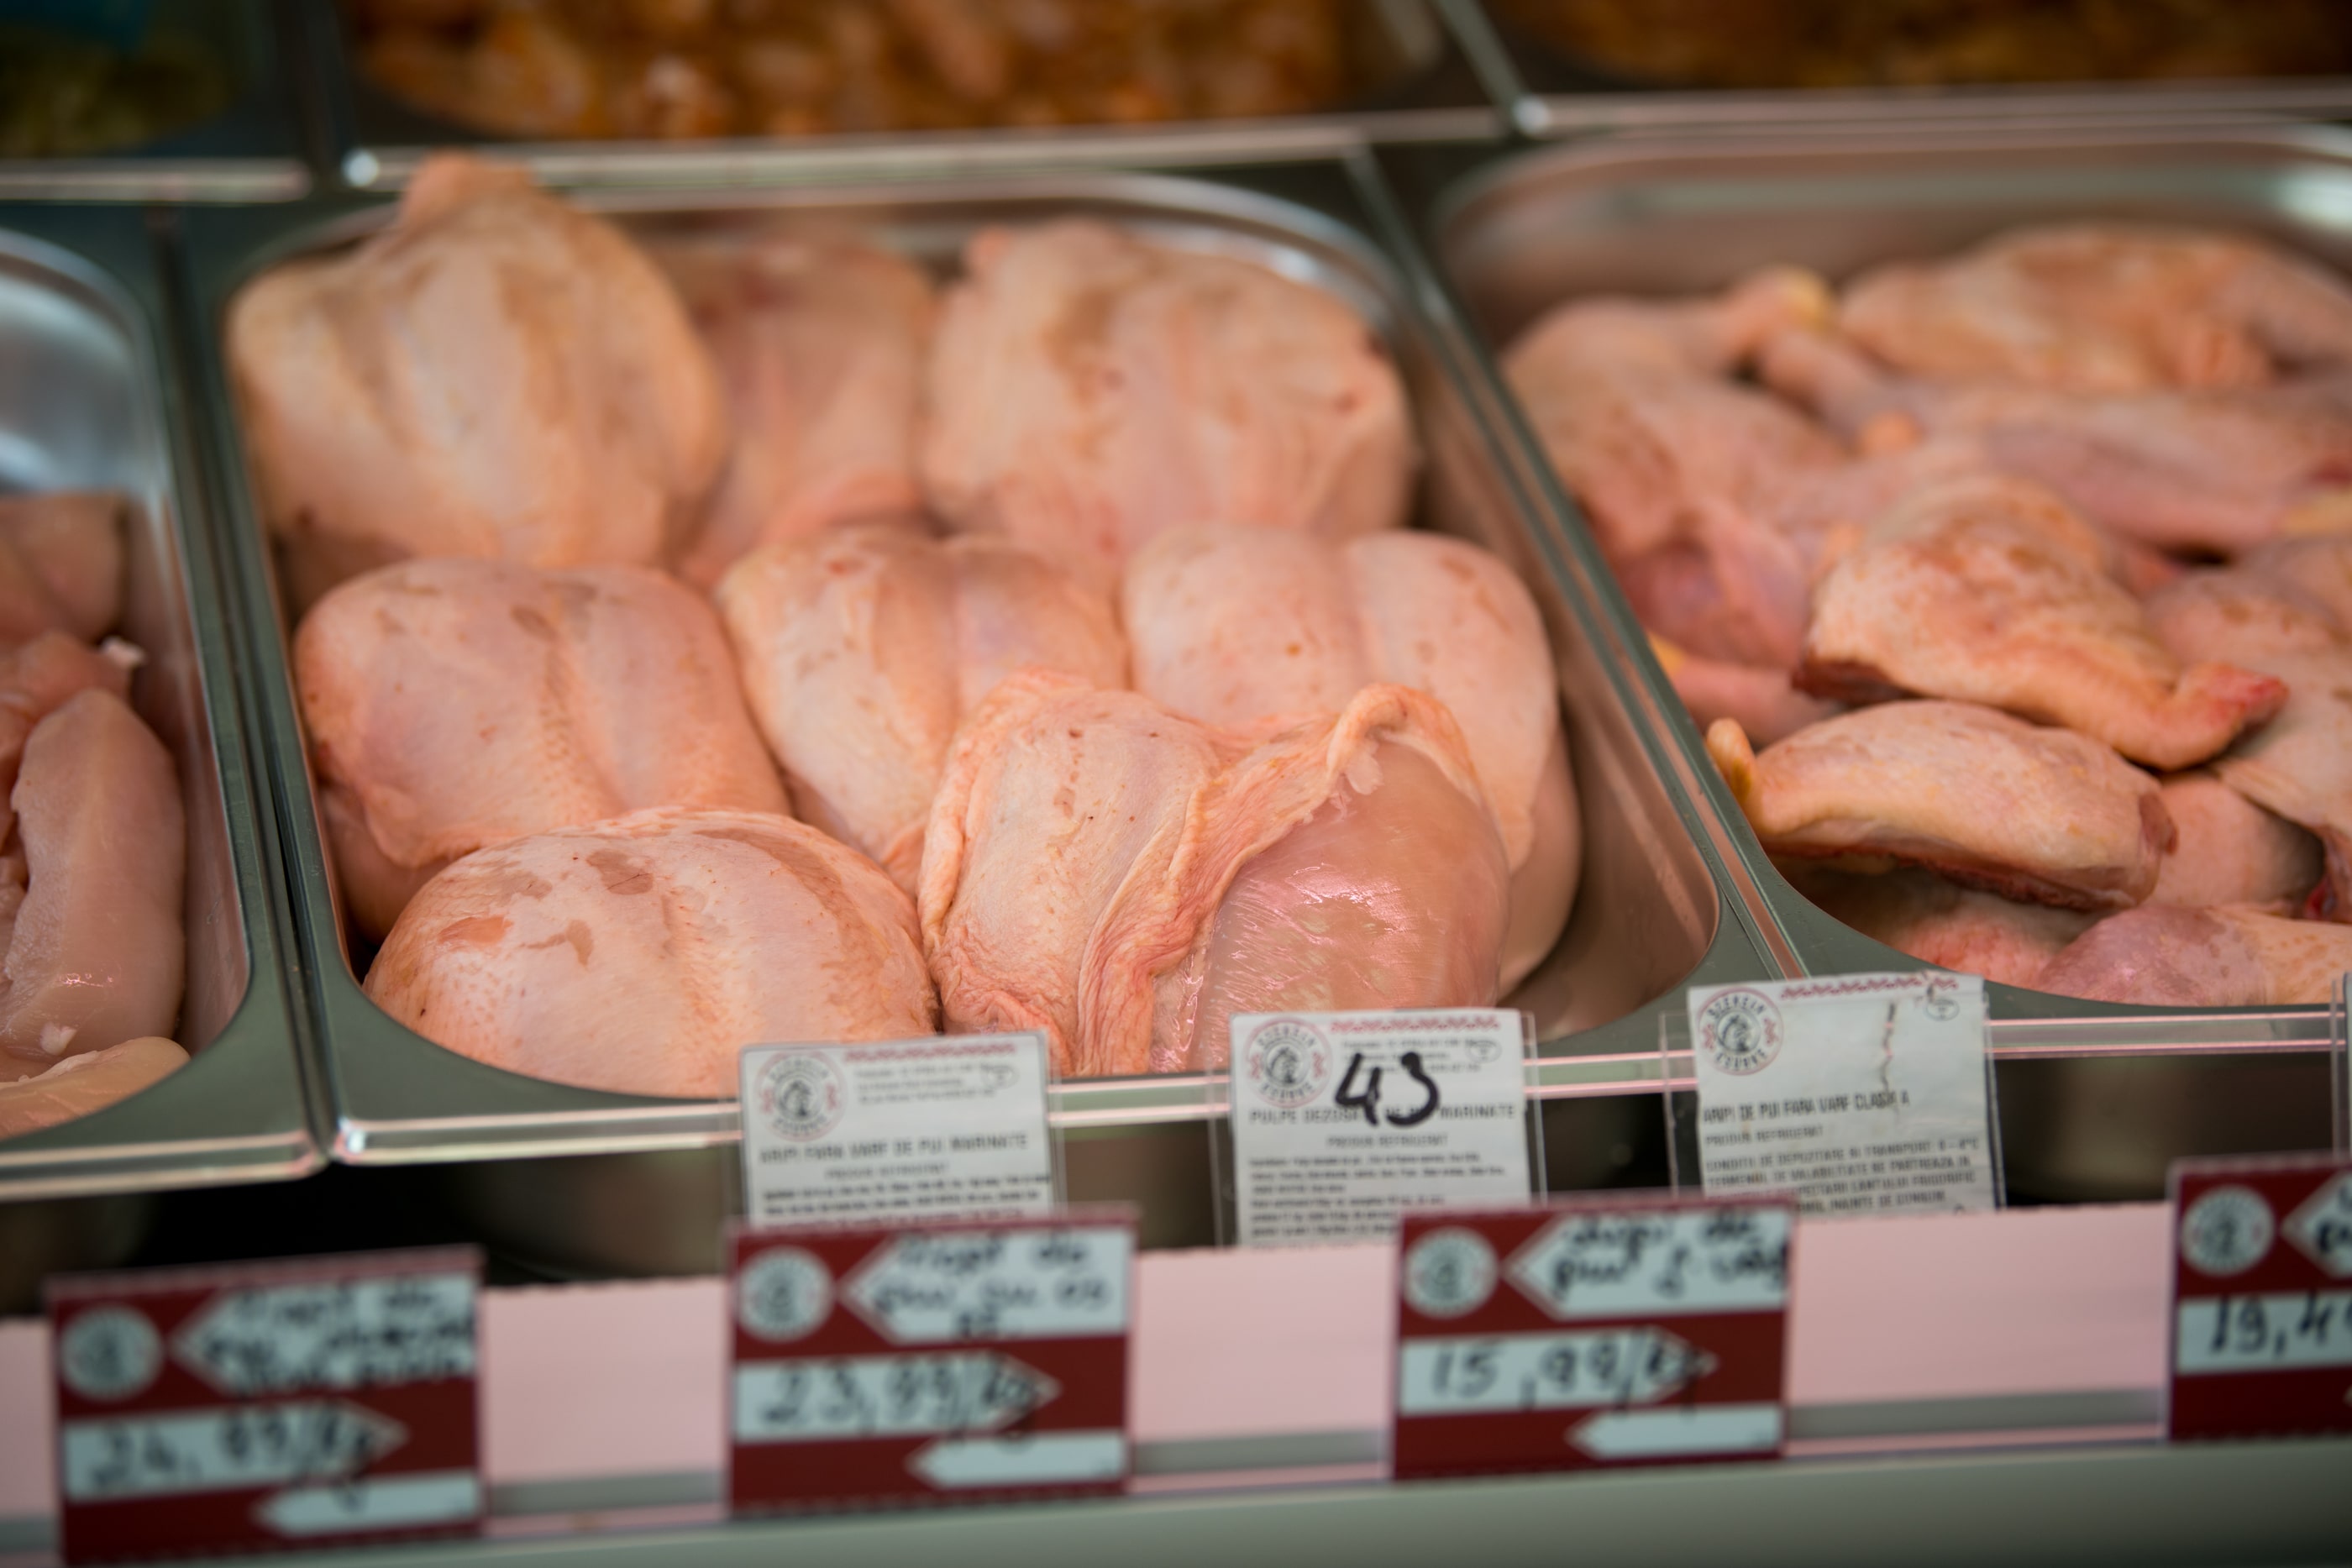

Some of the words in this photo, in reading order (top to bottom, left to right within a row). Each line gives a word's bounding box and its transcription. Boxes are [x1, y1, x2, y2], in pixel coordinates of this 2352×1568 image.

[1334, 1051, 1440, 1127] 43
[1740, 1102, 1755, 1121] DE
[1760, 1100, 1781, 1119] PUI
